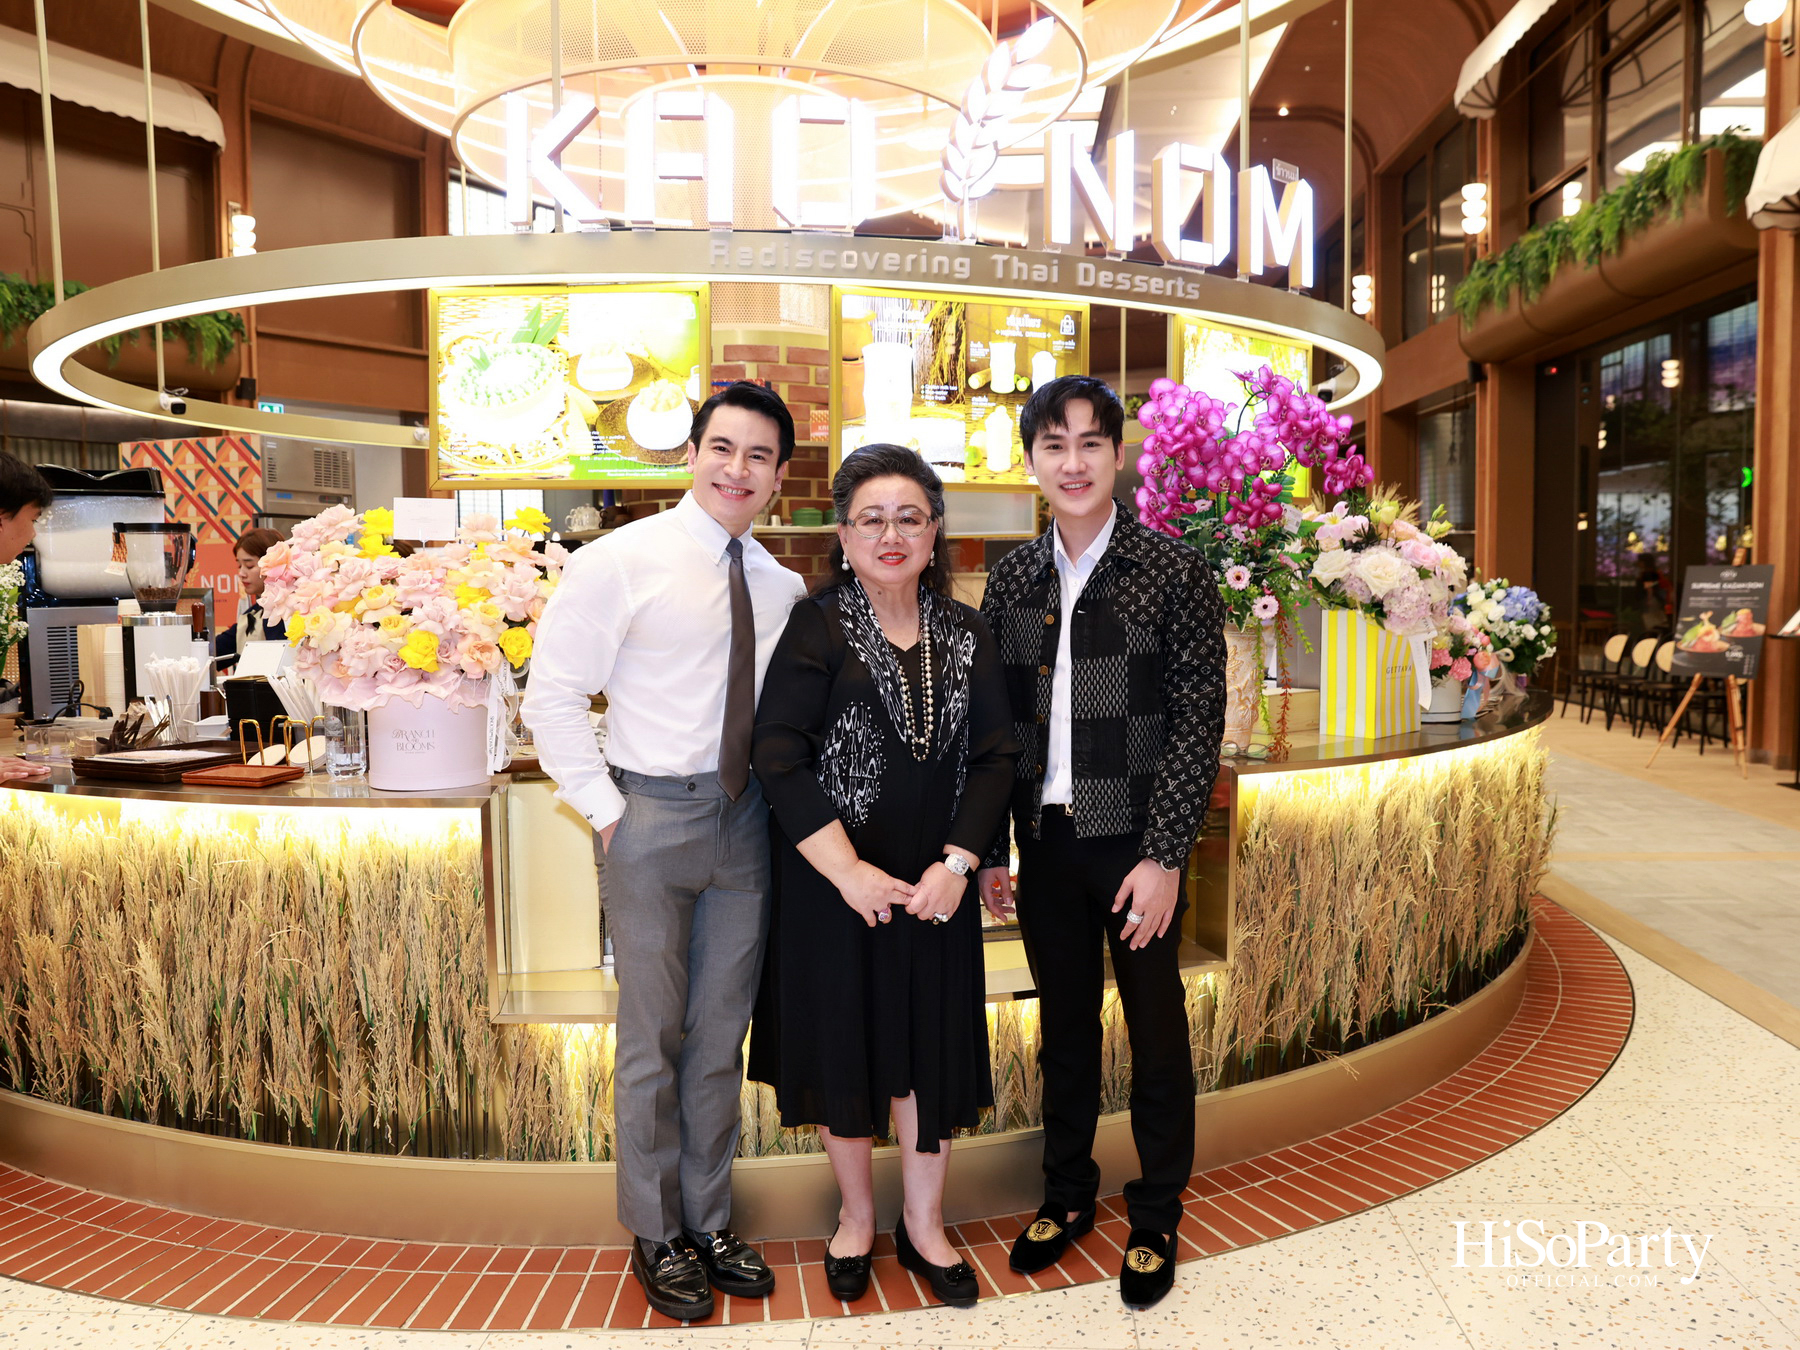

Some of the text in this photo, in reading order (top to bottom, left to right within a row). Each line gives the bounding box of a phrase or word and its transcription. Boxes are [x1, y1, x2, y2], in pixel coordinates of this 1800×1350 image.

[506, 91, 1314, 288] KAO NOM
[710, 240, 1201, 301] Rediscovering Thai Desserts
[392, 729, 435, 740] BRANCH
[397, 742, 435, 751] BLOOMS
